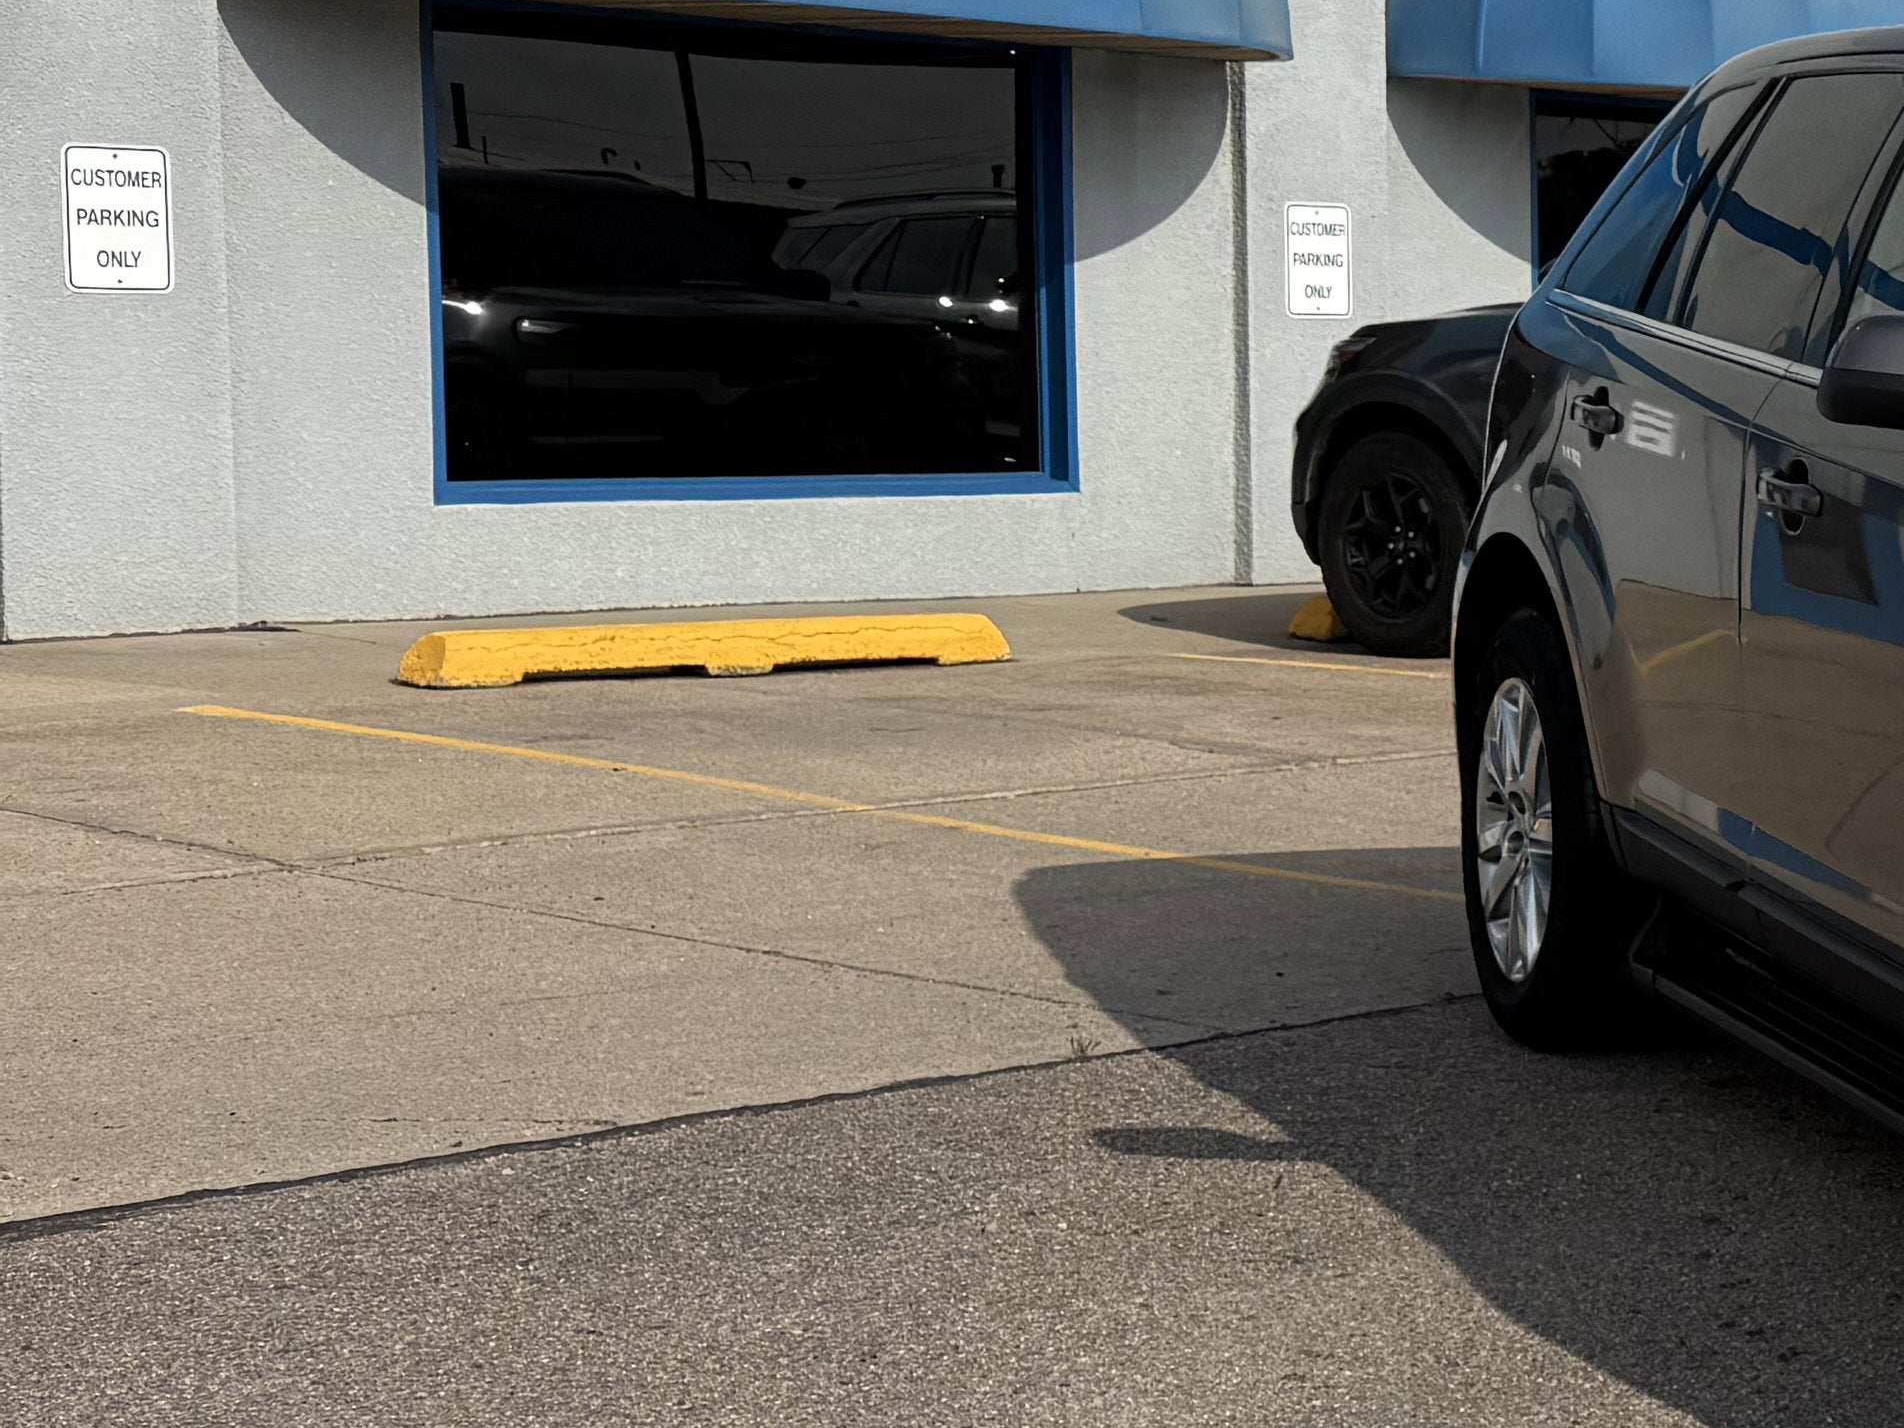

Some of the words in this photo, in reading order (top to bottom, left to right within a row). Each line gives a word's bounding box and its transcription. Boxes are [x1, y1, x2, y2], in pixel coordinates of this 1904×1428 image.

[70, 168, 162, 188] CUSTOMER
[76, 208, 159, 228] PARKING
[1290, 221, 1346, 236] CUSTOMER
[96, 250, 142, 268] ONLY
[1293, 252, 1344, 267] PARKING
[1304, 284, 1332, 299] ONLY
